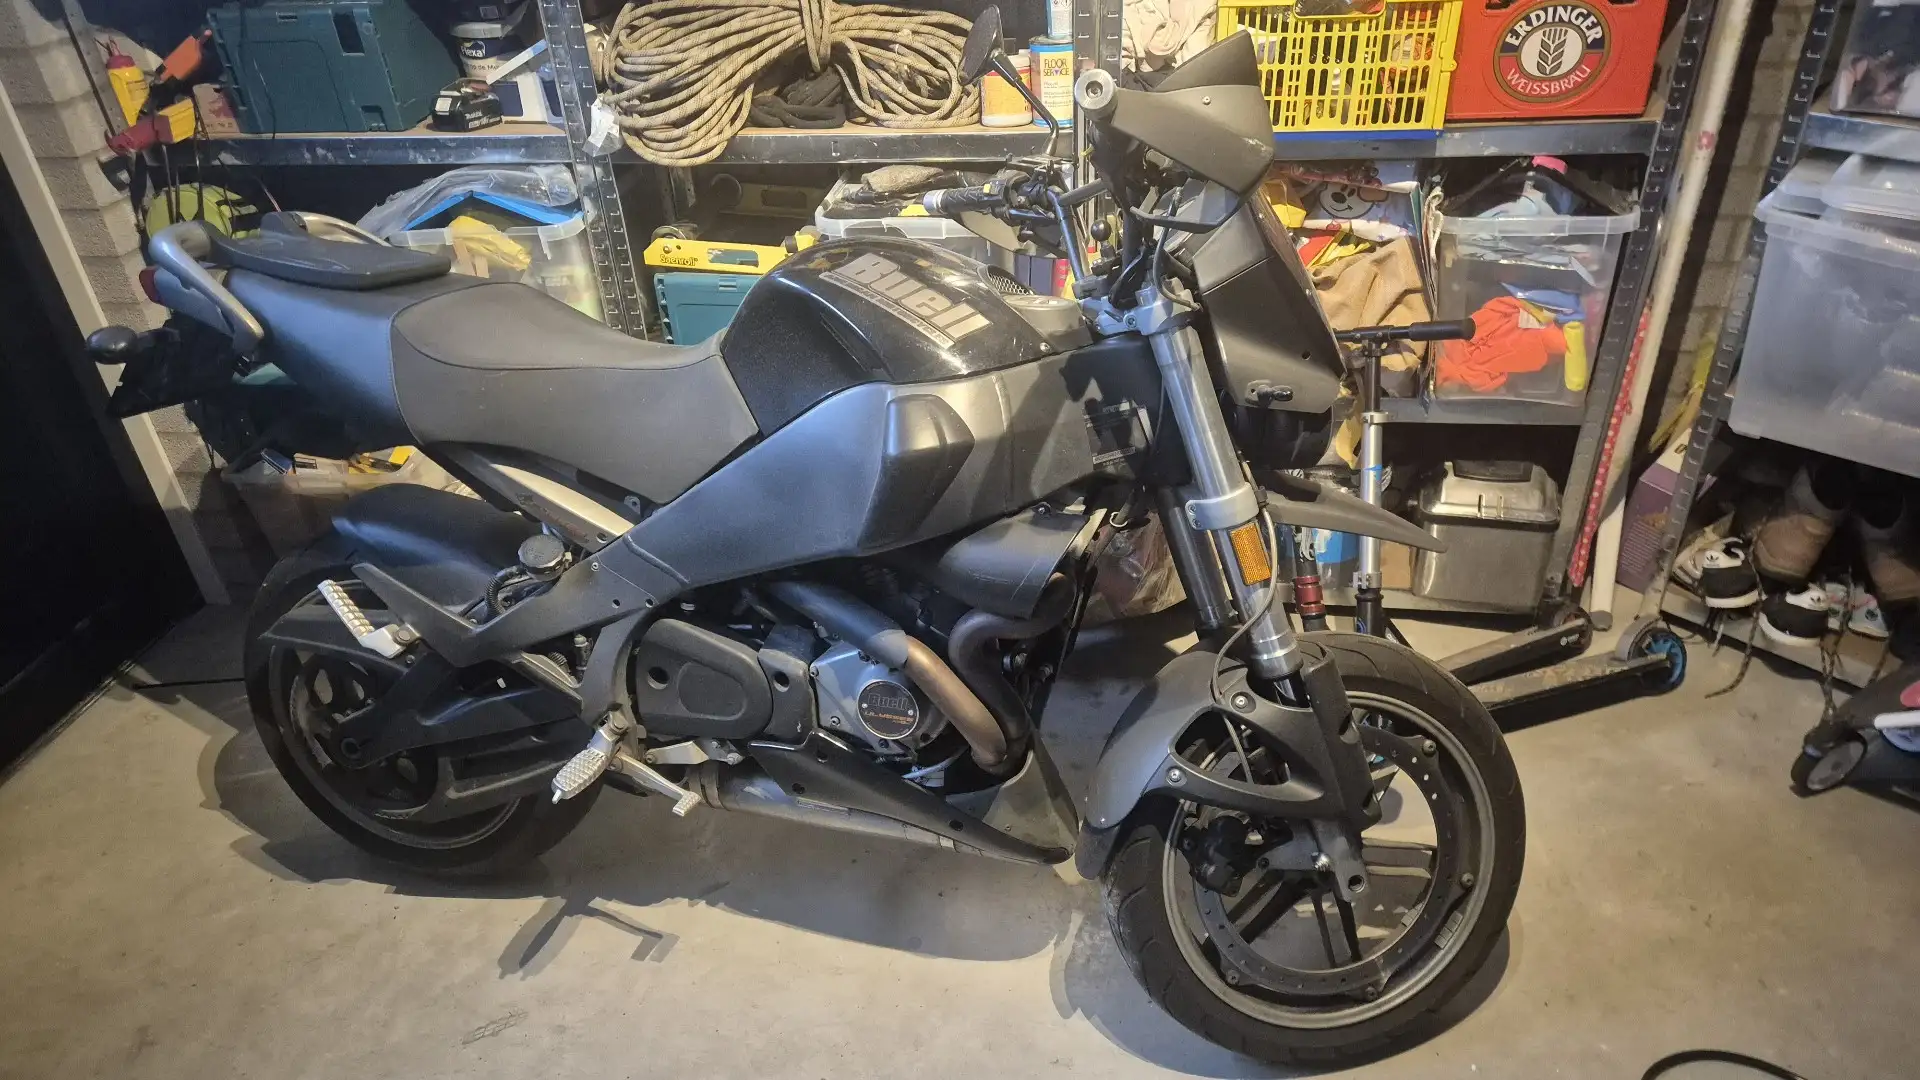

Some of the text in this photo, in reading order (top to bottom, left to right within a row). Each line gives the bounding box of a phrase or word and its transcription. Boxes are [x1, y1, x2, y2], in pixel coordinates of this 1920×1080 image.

[1505, 6, 1602, 46] ERDINGER
[460, 45, 484, 58] Flexa
[1044, 58, 1068, 69] FLOOR
[1507, 65, 1592, 95] WEISSBRÄU
[831, 252, 993, 341] Buell
[867, 693, 908, 711] Buell
